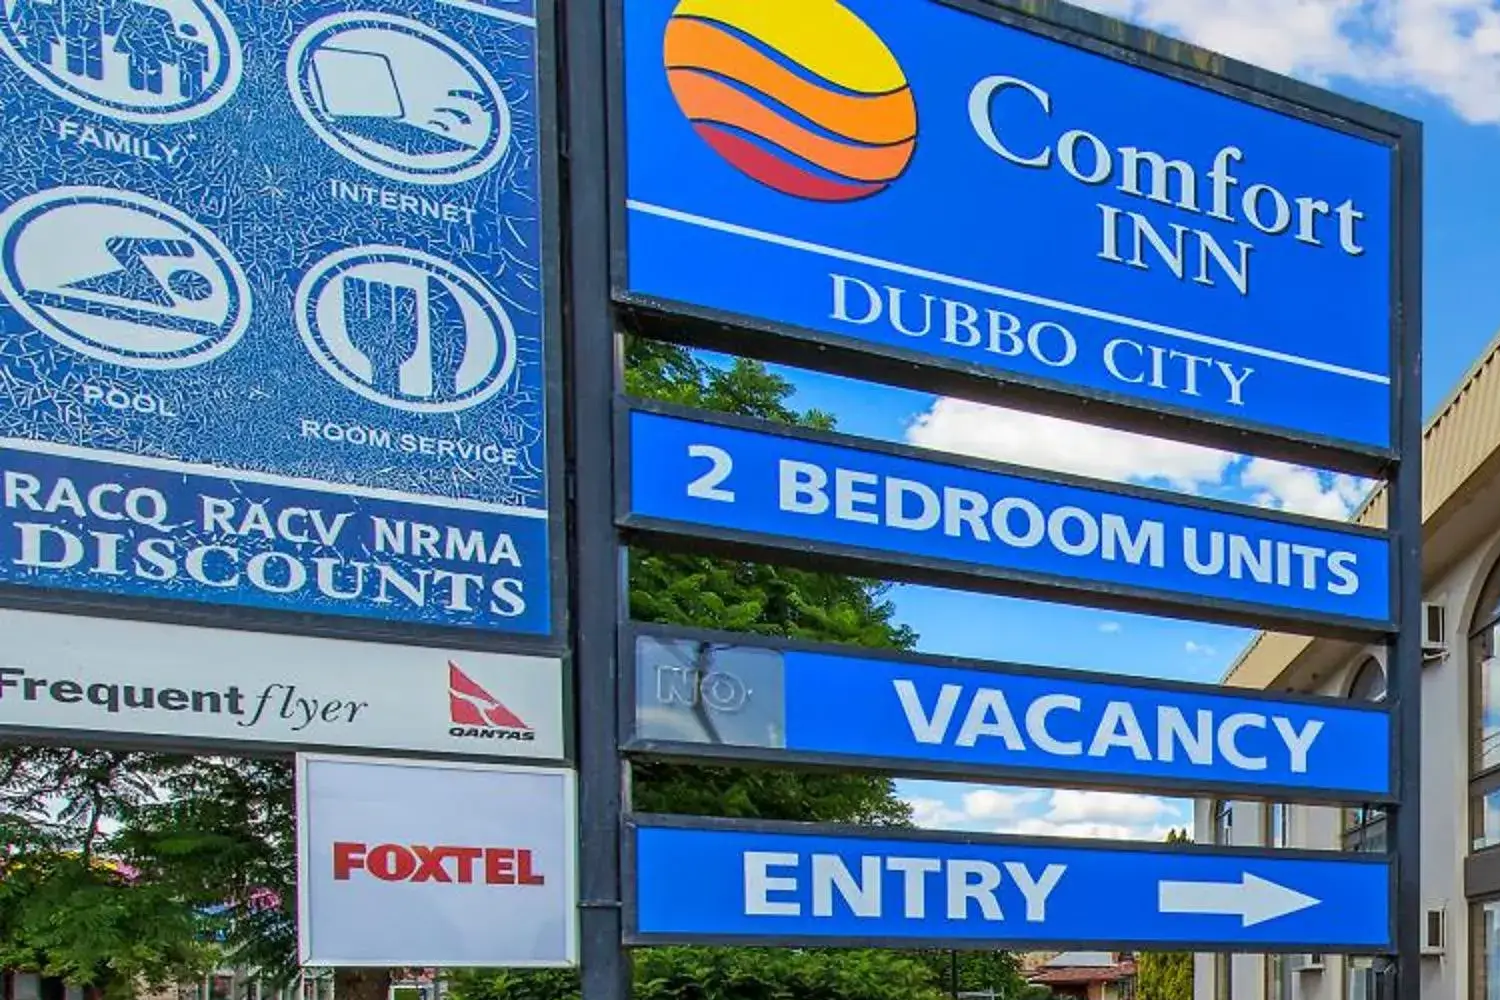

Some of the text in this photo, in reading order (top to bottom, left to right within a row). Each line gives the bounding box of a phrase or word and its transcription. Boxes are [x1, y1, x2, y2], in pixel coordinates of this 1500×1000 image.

[60, 120, 182, 166] FAMILY
[967, 75, 1365, 256] Comfort
[331, 180, 477, 225] INTERNET
[1097, 204, 1253, 296] INN
[828, 273, 1255, 406] DUBBO CITY
[83, 384, 178, 418] POOL
[301, 420, 518, 466] ROOM SERVICE
[3, 471, 522, 567] RACQ RACV NRMA
[687, 445, 1359, 595] 2 BEDROOM UNITS
[13, 521, 527, 617] DISCOUNTS
[0, 667, 369, 731] Frequent flyer
[448, 727, 536, 741] QANTAS
[655, 665, 1324, 773] NO VACANCY
[333, 841, 545, 886] FOXTEL
[743, 852, 1067, 923] ENTRY
